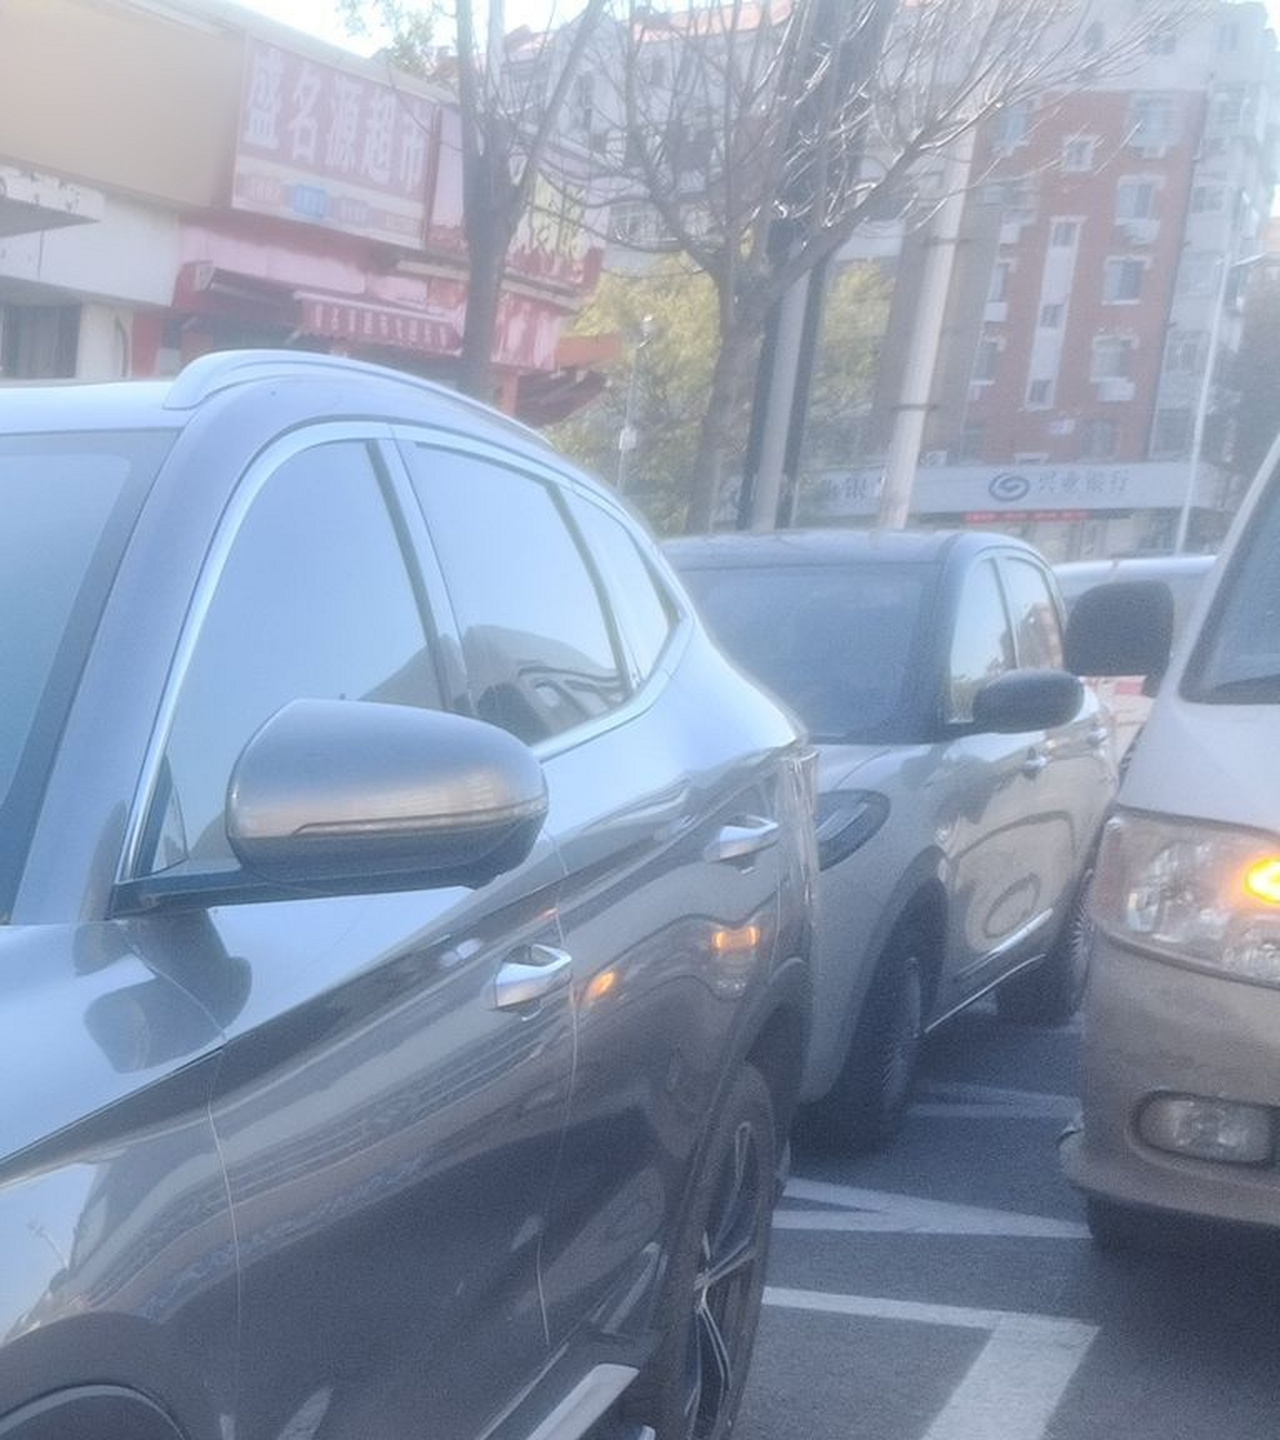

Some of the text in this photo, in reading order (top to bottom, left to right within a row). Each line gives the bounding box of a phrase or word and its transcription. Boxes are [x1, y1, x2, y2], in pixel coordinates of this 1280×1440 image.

[246, 45, 430, 193] 盛名源超市
